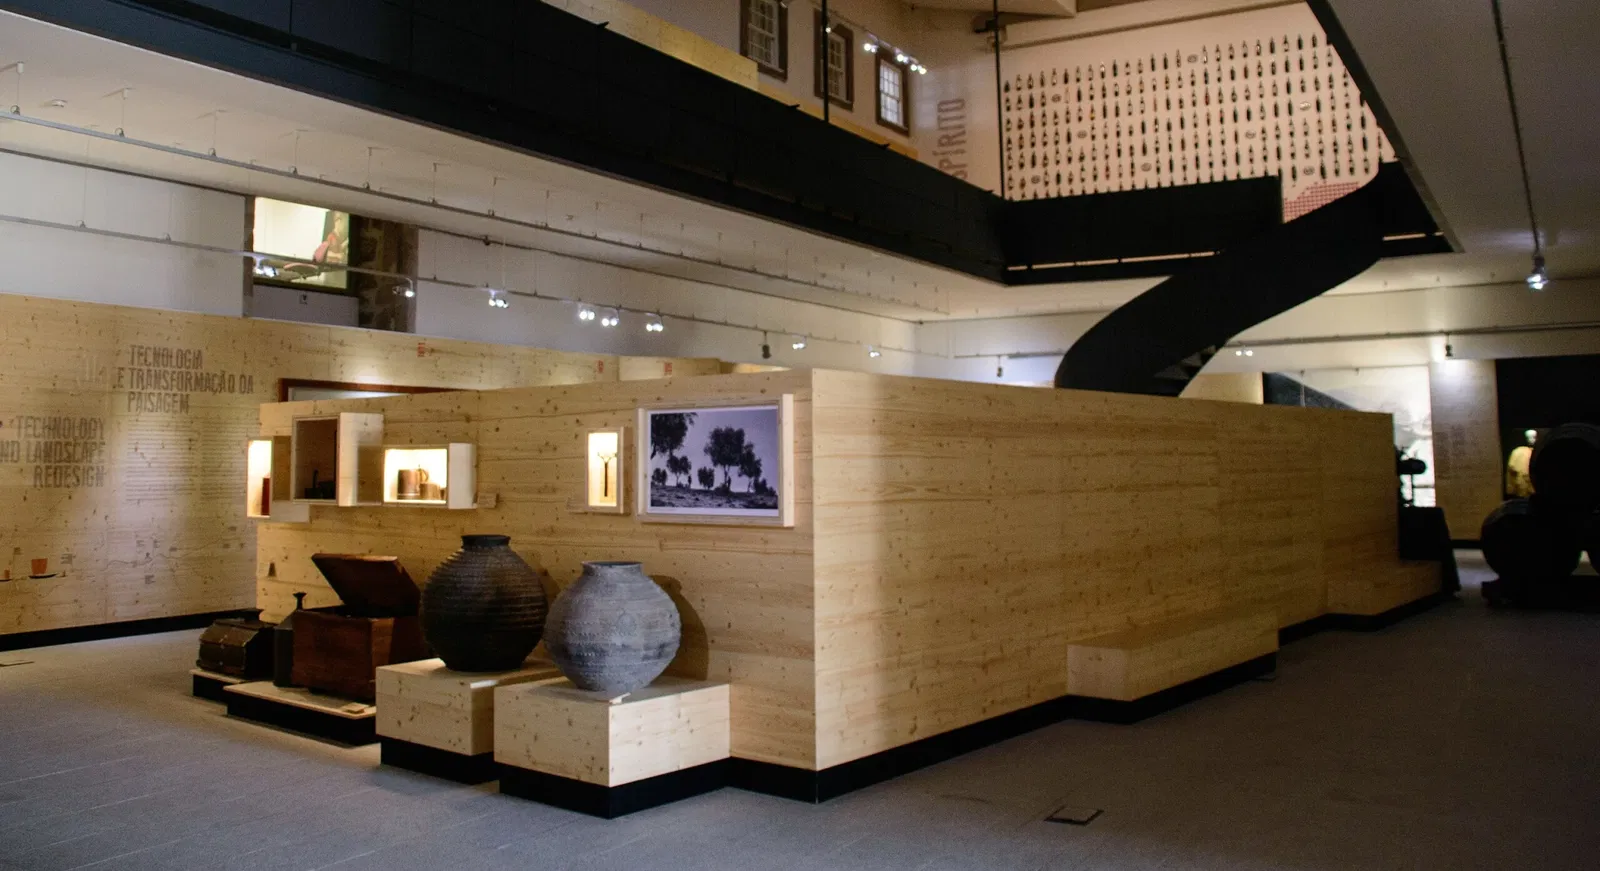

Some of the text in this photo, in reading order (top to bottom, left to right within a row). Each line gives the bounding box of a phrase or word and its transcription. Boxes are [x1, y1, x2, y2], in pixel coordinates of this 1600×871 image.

[130, 345, 203, 370] TECNOLOGIA
[117, 367, 124, 388] E
[128, 367, 235, 396] TRANSFORMAÇÃO
[239, 374, 254, 394] DA
[127, 391, 189, 414] PAISAGEM
[16, 415, 104, 439] TECHNOLOGY
[26, 440, 105, 463] LANDSCAPE
[34, 465, 104, 488] REDESIGN
